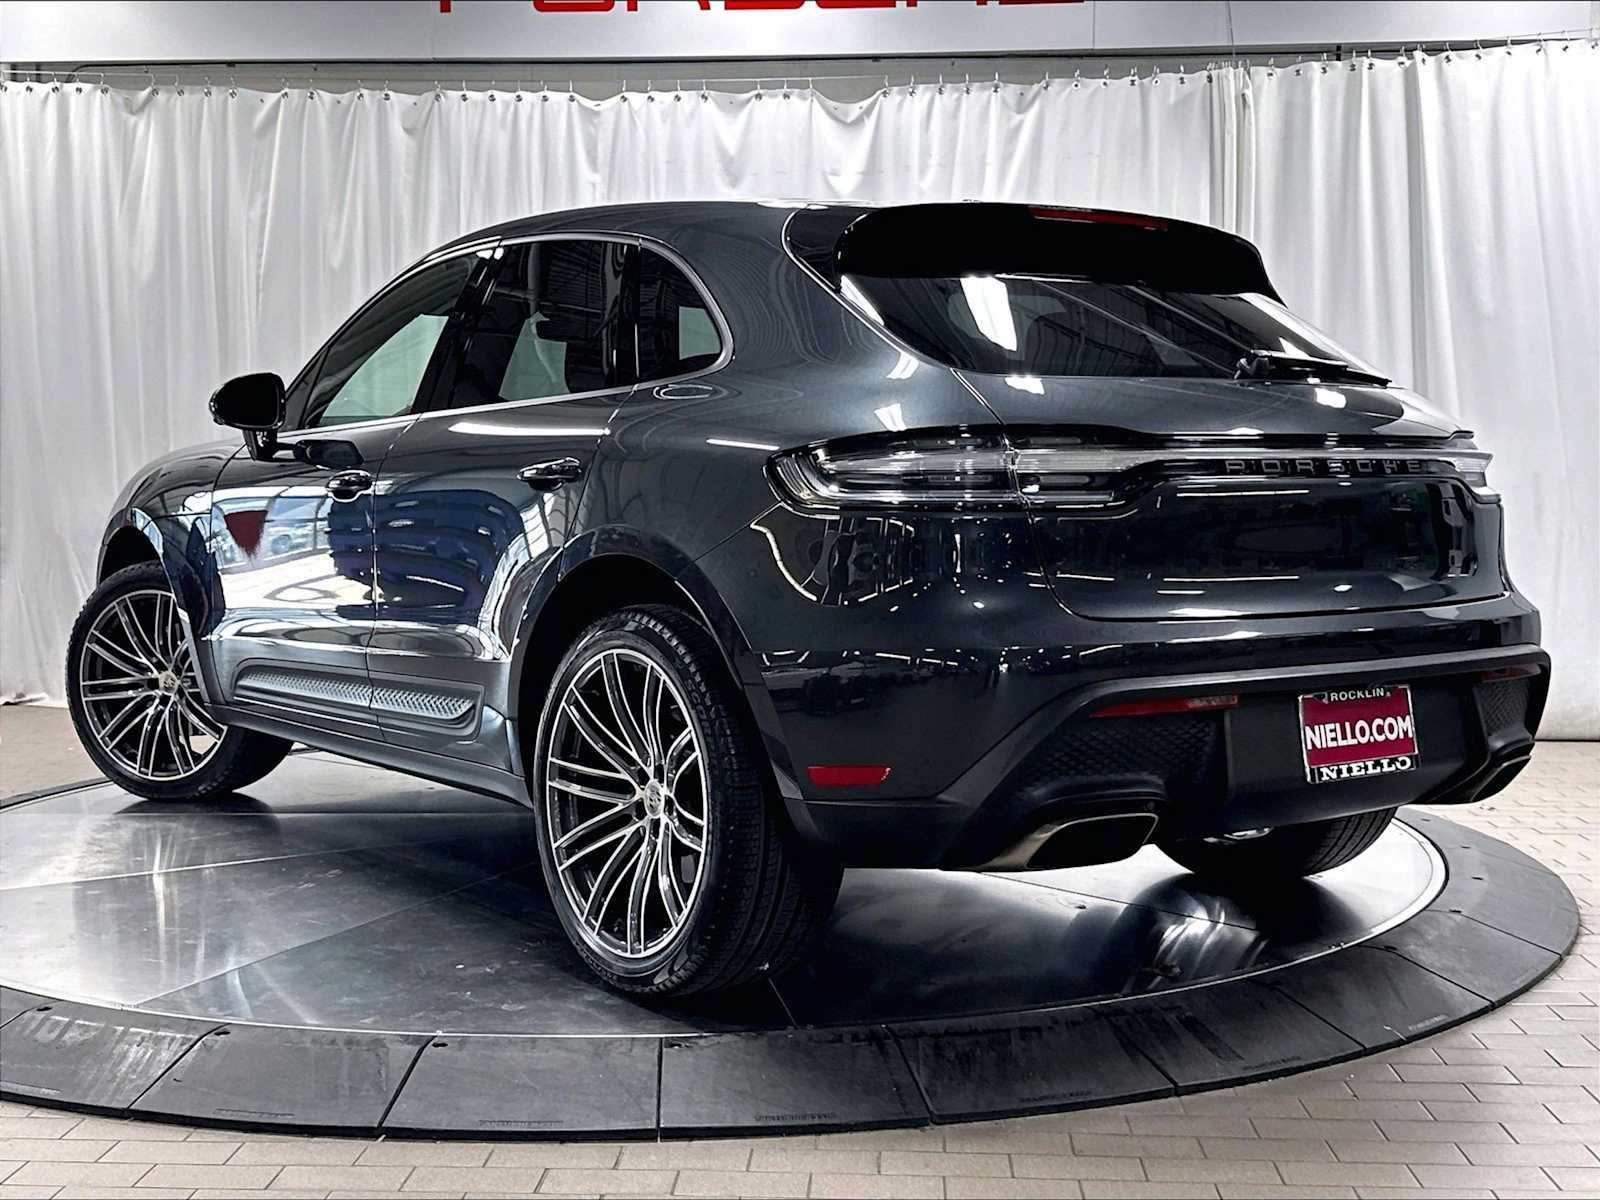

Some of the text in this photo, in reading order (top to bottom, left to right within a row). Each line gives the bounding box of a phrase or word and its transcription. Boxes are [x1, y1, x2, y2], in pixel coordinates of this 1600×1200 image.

[1225, 459, 1422, 475] PORSCHE
[1330, 687, 1385, 702] ROCKLIN
[1304, 714, 1413, 750] NIELLO.COM
[1320, 756, 1412, 781] NIELLO
